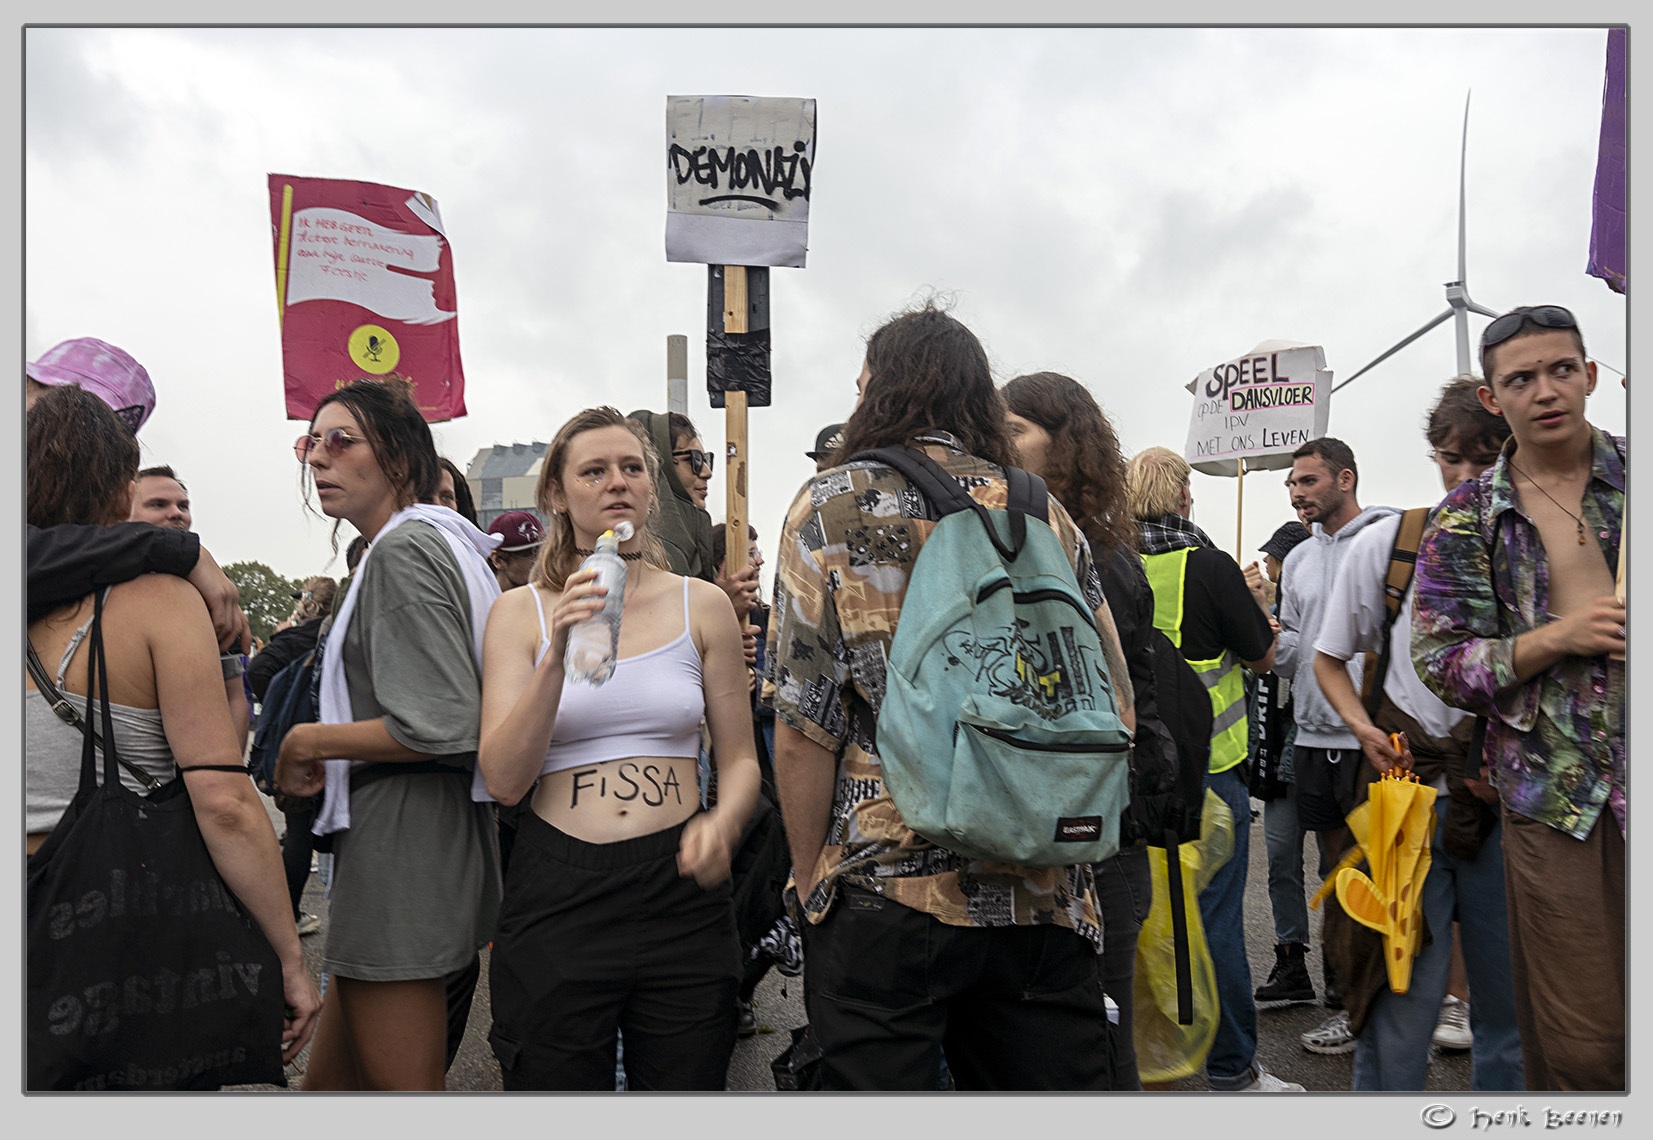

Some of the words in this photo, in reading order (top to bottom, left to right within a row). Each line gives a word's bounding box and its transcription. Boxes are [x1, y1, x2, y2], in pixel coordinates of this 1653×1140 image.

[1205, 352, 1290, 400] SPEEL
[1231, 386, 1313, 410] DANSVLOER
[1197, 436, 1222, 456] MET
[1231, 434, 1255, 451] ONS
